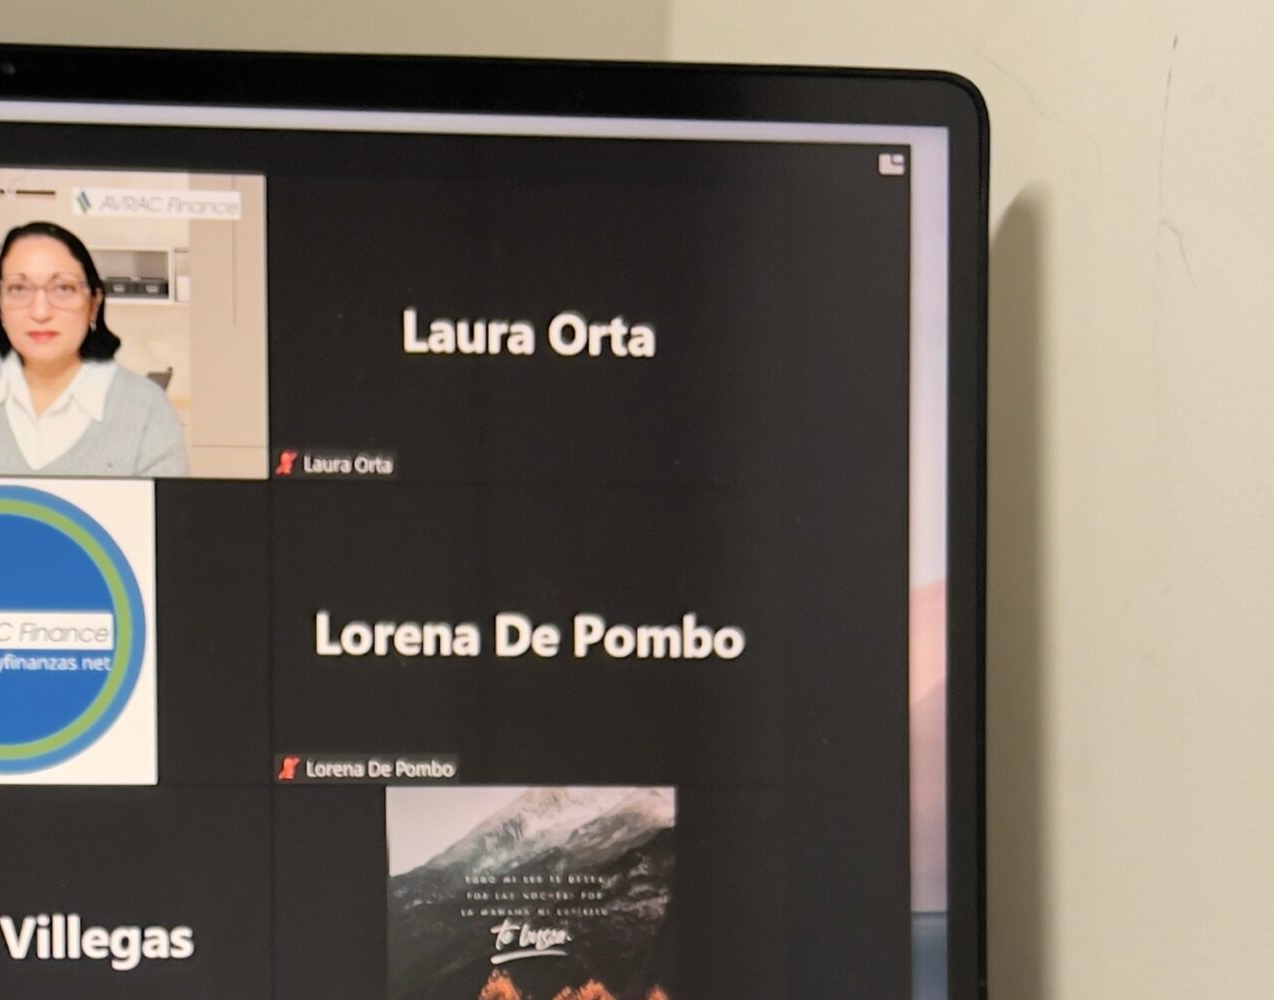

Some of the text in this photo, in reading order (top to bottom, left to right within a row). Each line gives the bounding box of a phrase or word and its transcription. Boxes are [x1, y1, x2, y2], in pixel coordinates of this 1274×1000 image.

[167, 195, 239, 214] Finance
[403, 306, 656, 358] Laura Orta
[303, 453, 394, 475] Laura Orta
[18, 622, 110, 644] Finance
[314, 608, 746, 660] Lorena De Pombo
[306, 759, 457, 779] Lorena De Pombo
[0, 914, 194, 971] Villegas
